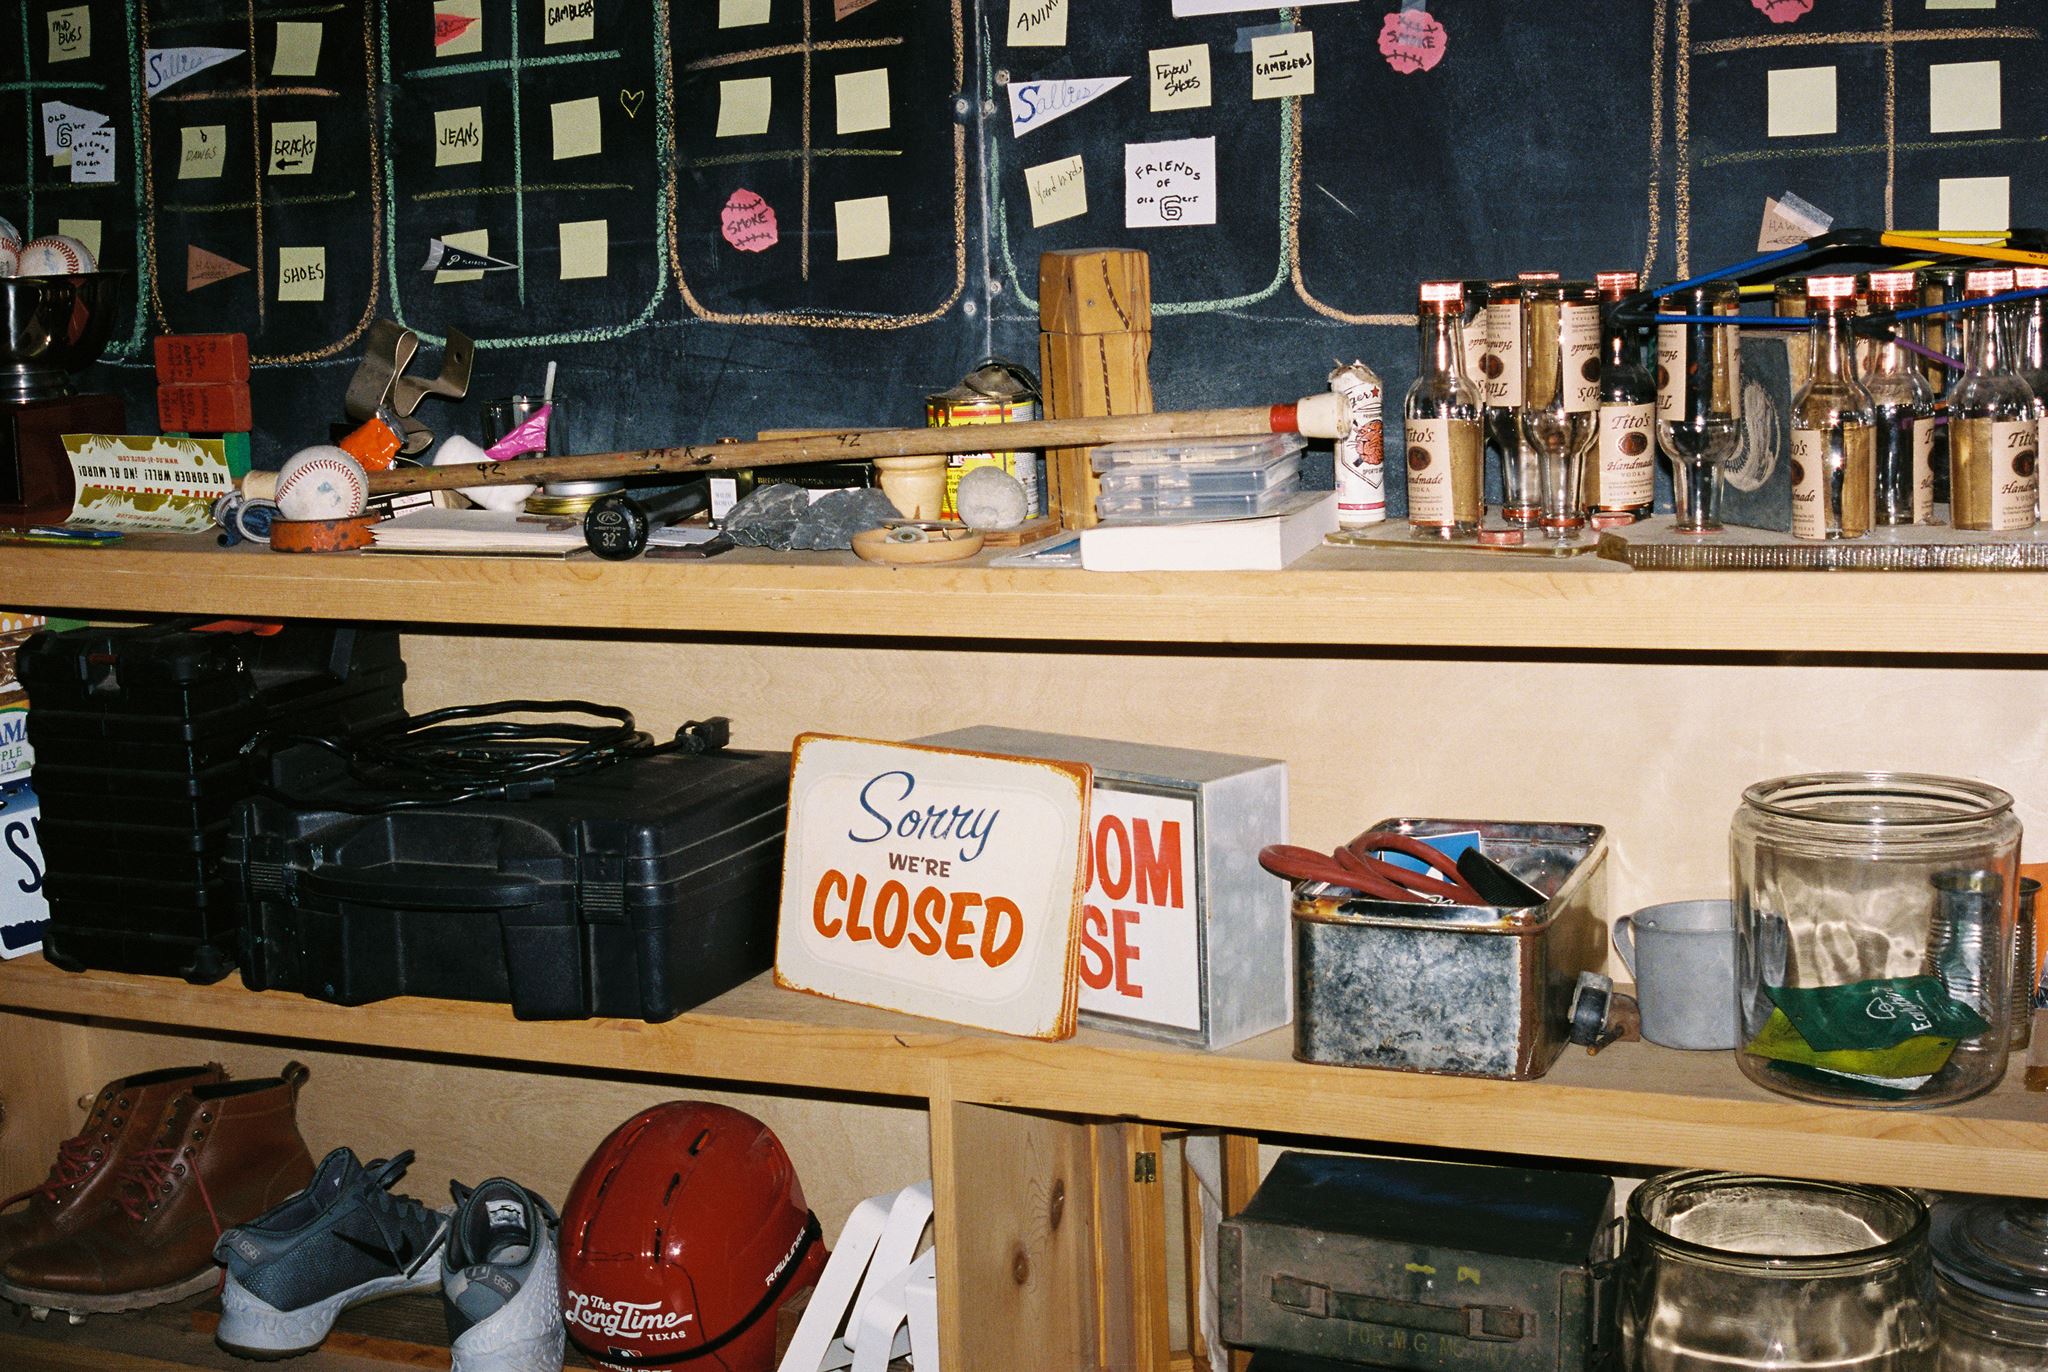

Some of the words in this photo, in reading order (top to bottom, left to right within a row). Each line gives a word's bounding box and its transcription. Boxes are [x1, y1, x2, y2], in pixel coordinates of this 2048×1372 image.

[1256, 53, 1312, 75] GAMBLERS
[1014, 80, 1100, 123] Sallies
[440, 122, 479, 147] JEANS
[274, 134, 316, 157] GRACKS
[1135, 160, 1201, 182] FRIENDS
[727, 208, 768, 235] SMOKE
[283, 263, 324, 284] SHOES
[1611, 412, 1651, 430] Tito's
[836, 433, 860, 448] 42
[78, 465, 107, 478] MURO!
[110, 466, 120, 479] AL
[144, 468, 172, 482] WALL!
[175, 470, 209, 484] BORDER
[213, 472, 225, 485] NO
[477, 463, 506, 480] 42
[849, 771, 1000, 862] Sorry
[888, 852, 951, 878] WE'RE
[1085, 814, 1184, 909] OM
[813, 869, 1023, 968] CLOSED
[590, 1295, 612, 1311] The
[647, 1330, 686, 1342] TEXAS
